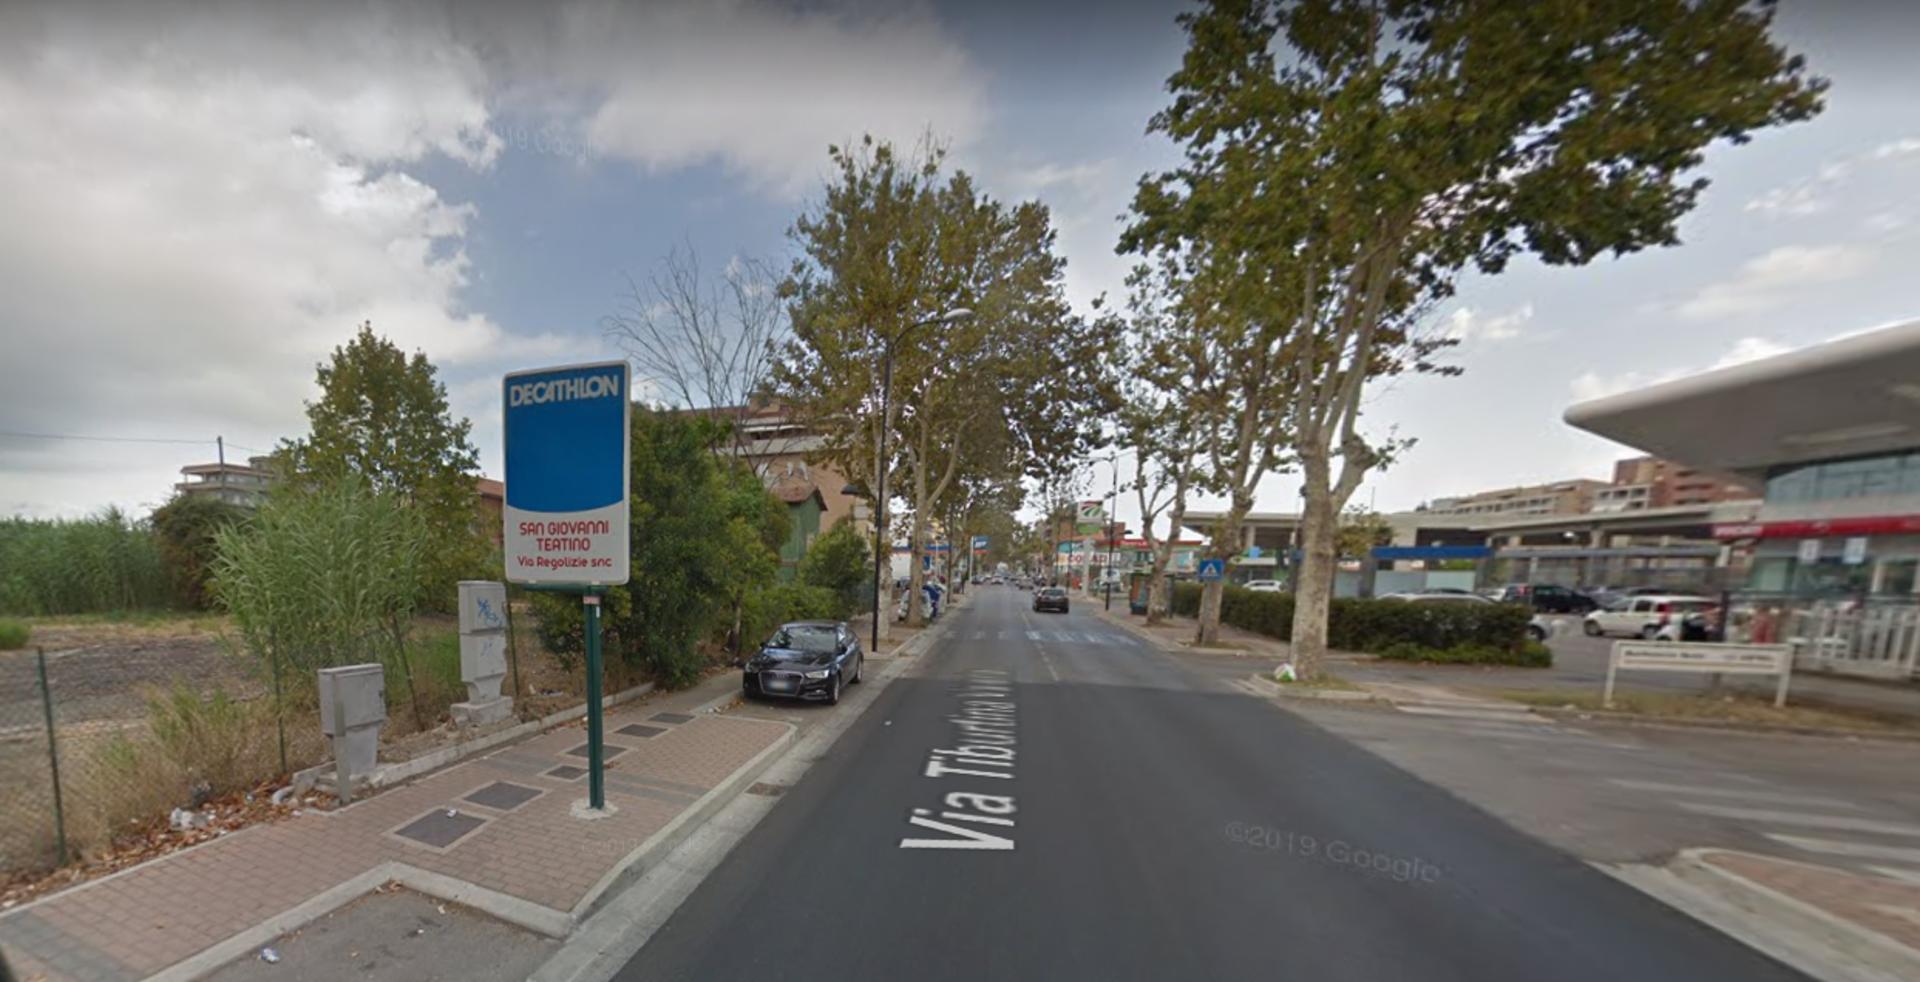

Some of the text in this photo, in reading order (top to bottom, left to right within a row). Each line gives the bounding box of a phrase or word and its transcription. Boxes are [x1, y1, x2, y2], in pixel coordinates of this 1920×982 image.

[509, 374, 619, 407] DECATHLON
[519, 520, 609, 536] SAN GIOVANNI
[536, 537, 591, 552] TEATINO
[517, 555, 613, 571] Via Regolizie snc
